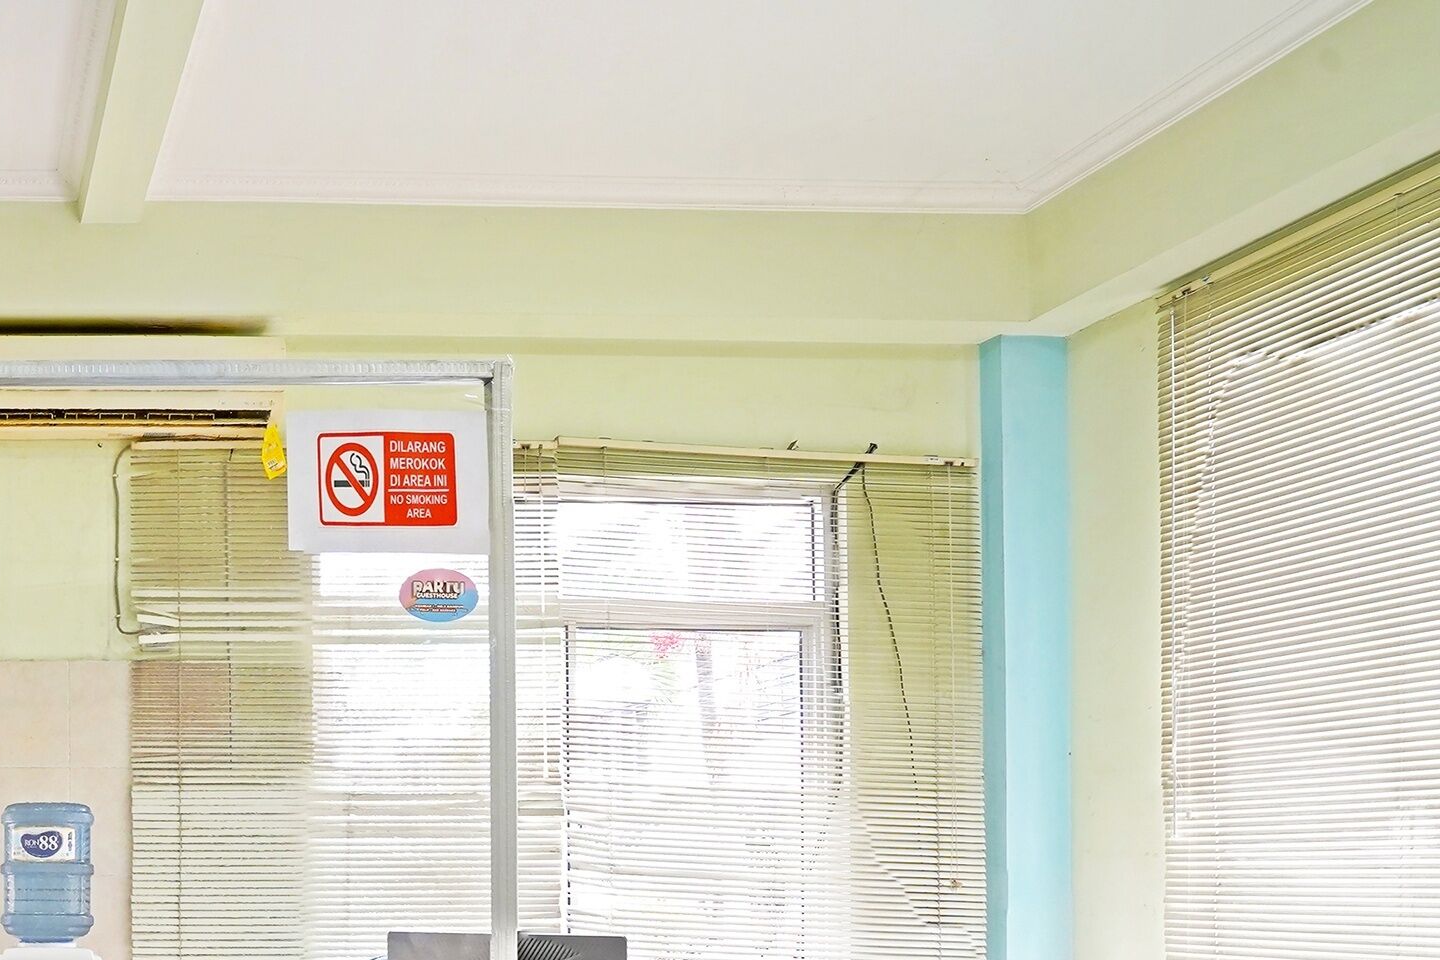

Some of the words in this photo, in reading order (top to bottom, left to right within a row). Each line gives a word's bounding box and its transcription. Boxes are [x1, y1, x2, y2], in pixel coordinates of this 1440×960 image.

[389, 440, 446, 454] DILARANG
[389, 457, 446, 471] MEROKOK
[390, 474, 402, 487] DI
[403, 474, 432, 487] AREA
[433, 474, 448, 487] INI
[390, 494, 404, 505] NO
[405, 494, 448, 506] SMOKING
[406, 508, 432, 519] AREA
[39, 834, 59, 851] 88
